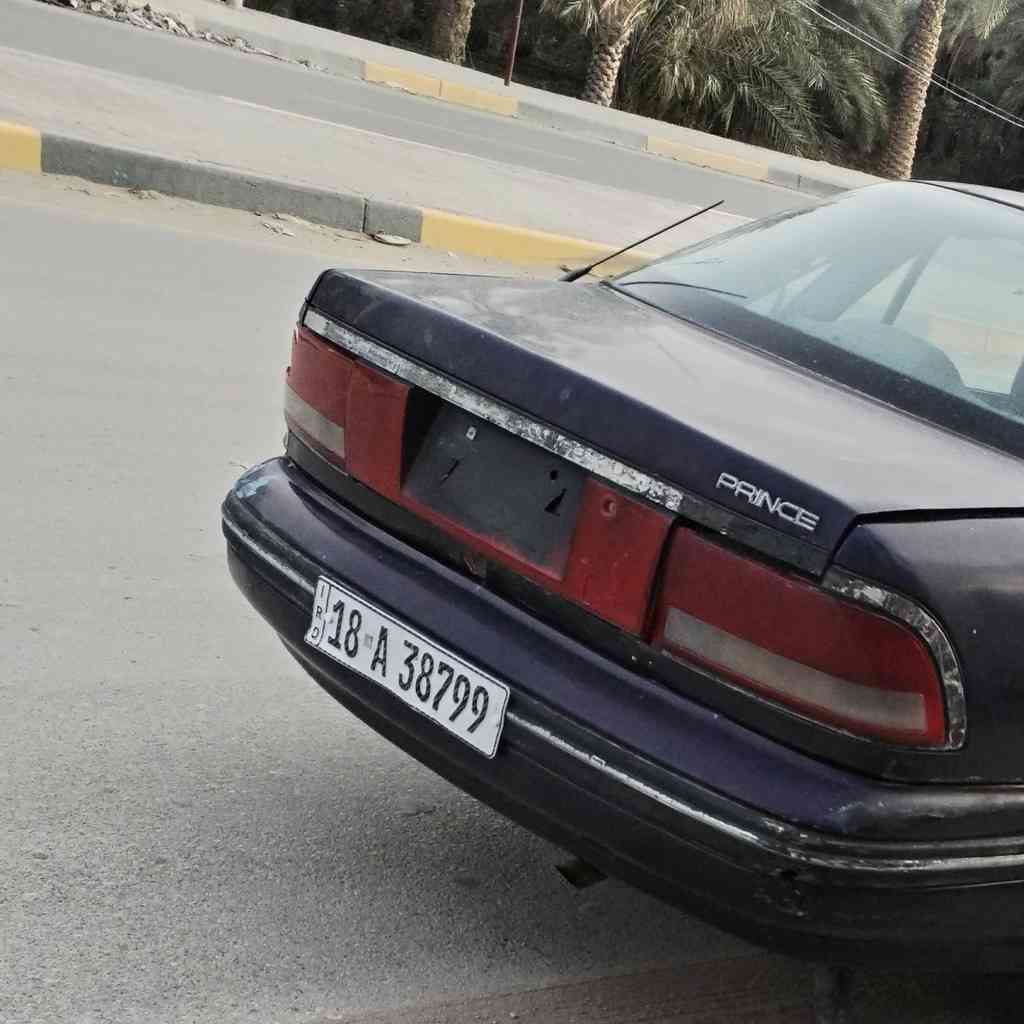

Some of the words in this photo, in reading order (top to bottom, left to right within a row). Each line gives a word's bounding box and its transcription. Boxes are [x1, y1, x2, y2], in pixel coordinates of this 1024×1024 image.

[715, 472, 820, 532] PRINCE
[327, 600, 362, 658] 18
[370, 625, 388, 677] A
[398, 639, 490, 734] 38799
